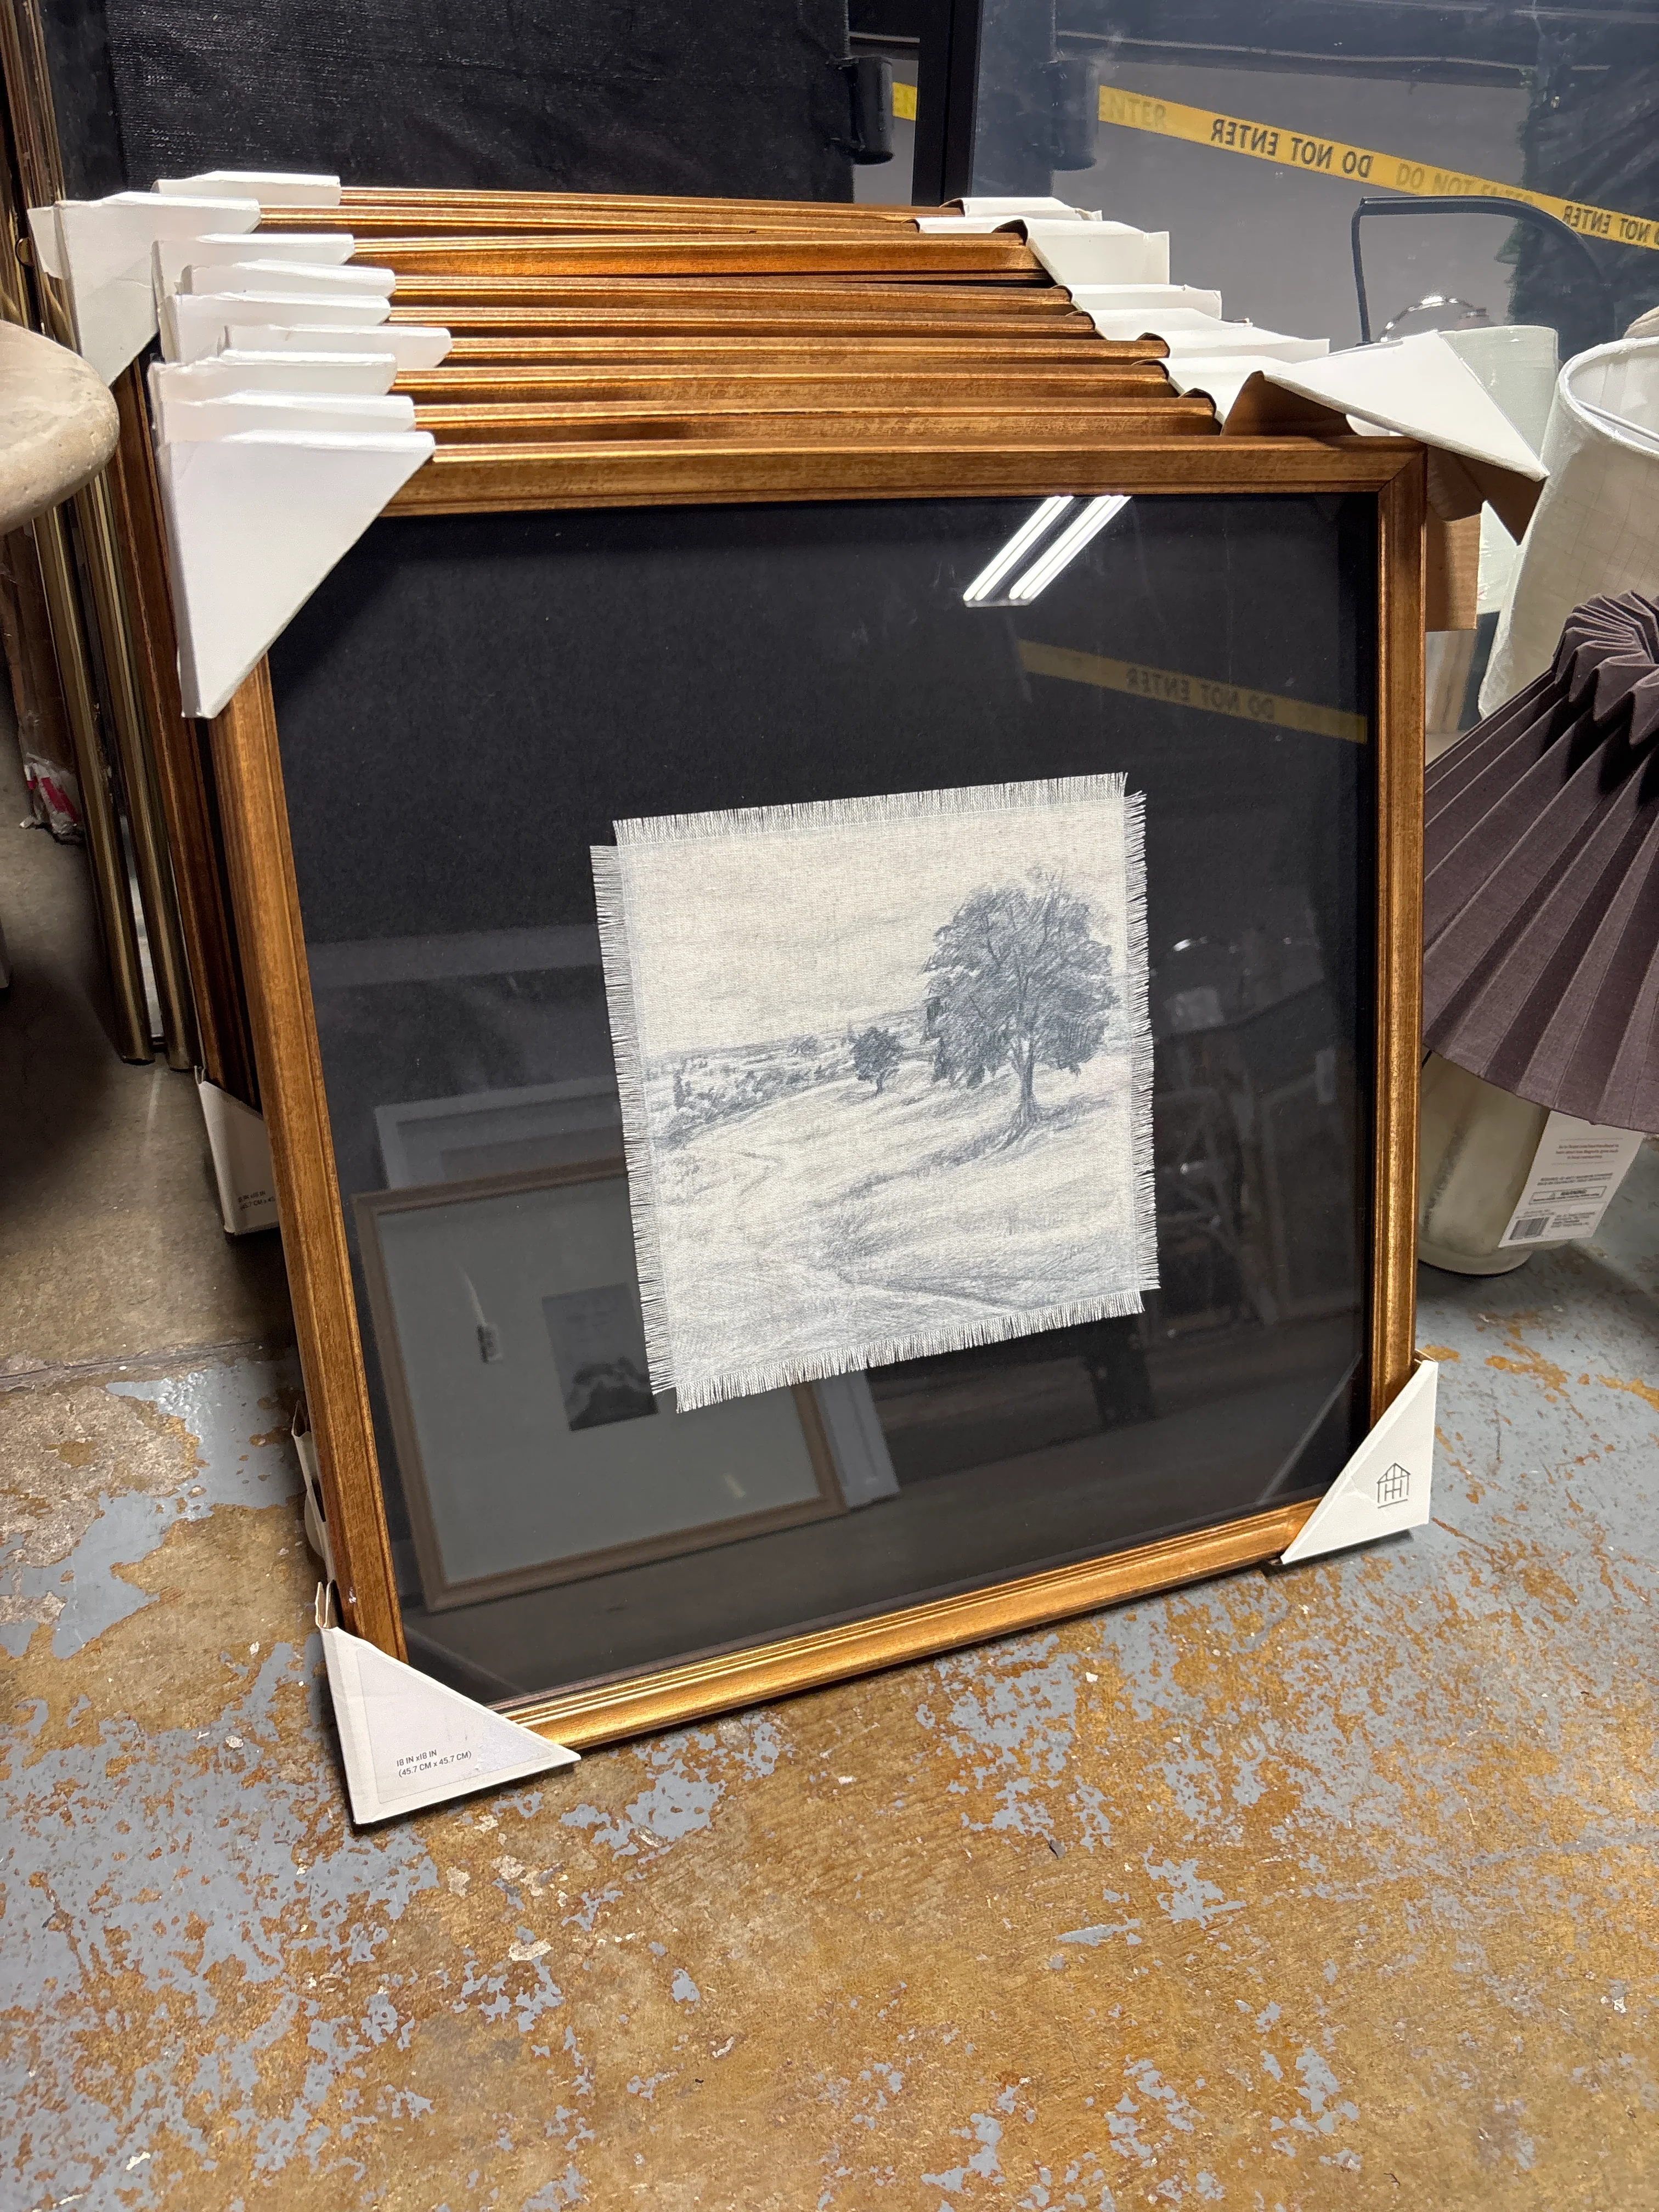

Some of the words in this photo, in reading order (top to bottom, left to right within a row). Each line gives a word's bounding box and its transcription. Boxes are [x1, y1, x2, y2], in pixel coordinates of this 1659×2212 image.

[1395, 163, 1425, 189] DO
[1432, 173, 1475, 195] NOT
[396, 1759, 404, 1767] 18
[406, 1756, 414, 1764] IN
[428, 1749, 437, 1758] IN
[398, 1765, 417, 1778] (45.7
[419, 1762, 432, 1771] CM
[438, 1755, 455, 1765] 45.7
[456, 1750, 472, 1760] CM)
